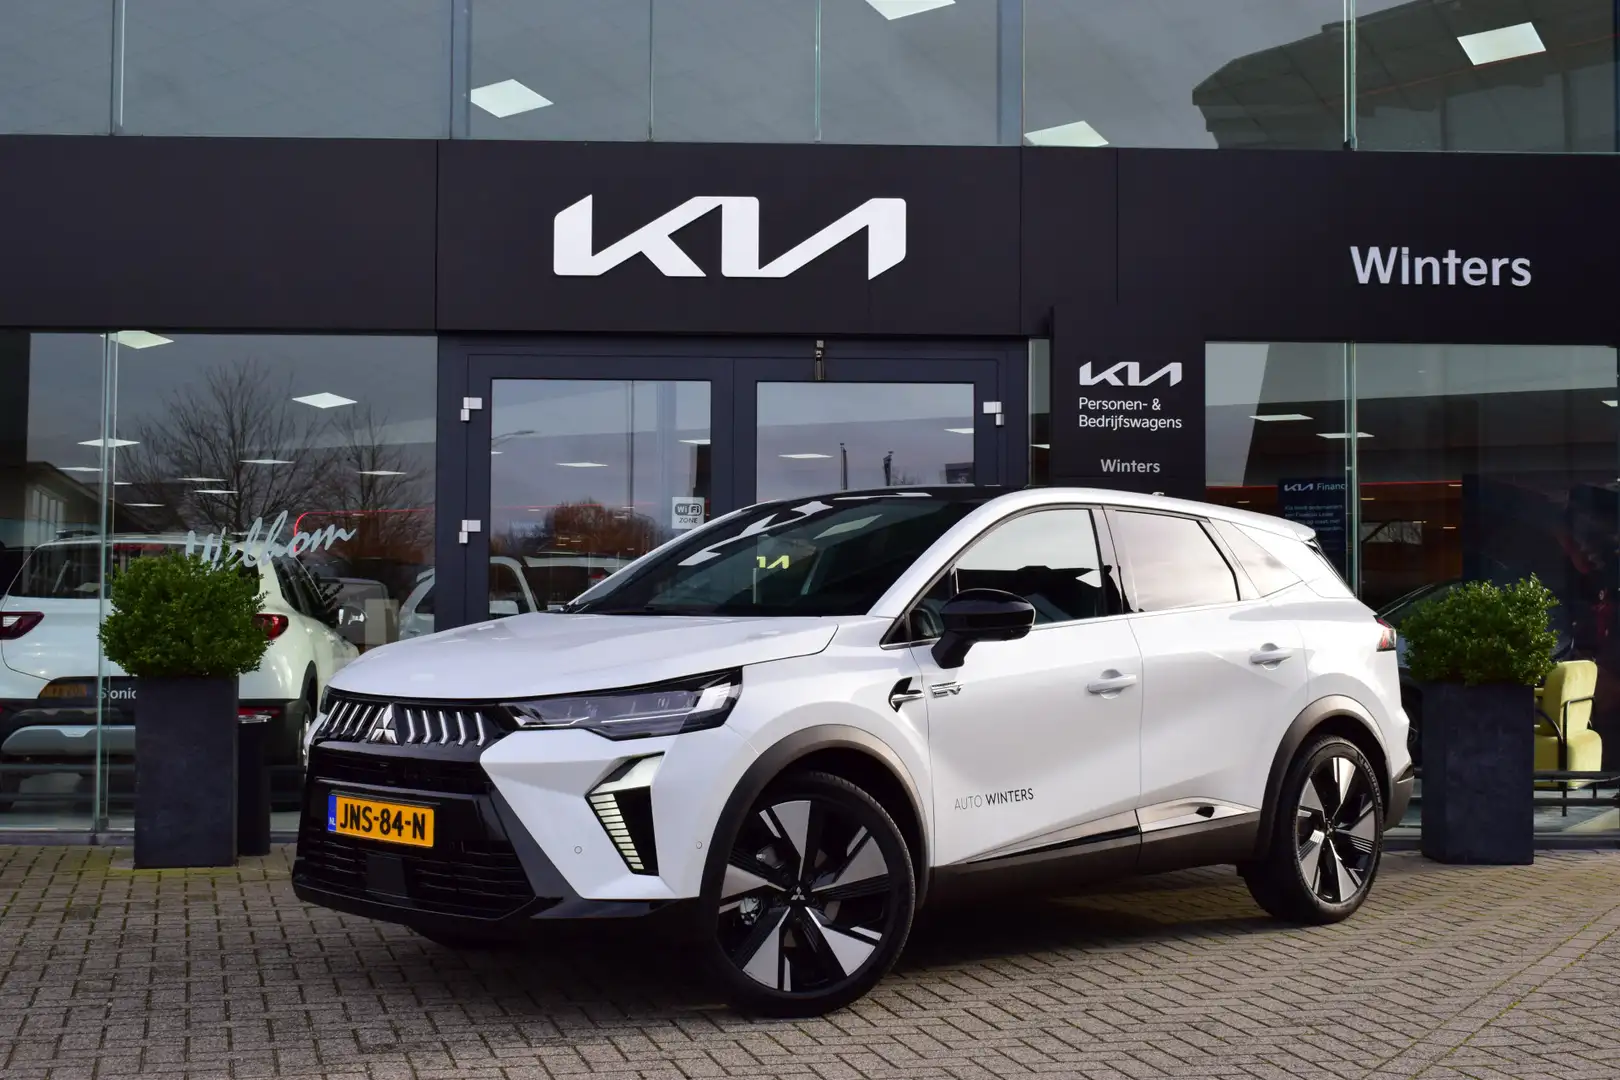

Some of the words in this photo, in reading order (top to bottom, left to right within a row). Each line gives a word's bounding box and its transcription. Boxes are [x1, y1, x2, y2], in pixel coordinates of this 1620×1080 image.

[553, 193, 906, 280] KIA
[1350, 246, 1532, 286] Winters
[1079, 361, 1182, 387] KIA
[1079, 397, 1148, 410] Personen-
[1151, 398, 1161, 410] &
[1079, 414, 1182, 431] Bedrijfswagens
[1100, 459, 1160, 473] Winters
[1317, 482, 1348, 490] Financ
[954, 795, 982, 810] AUTO
[985, 788, 1034, 805] WINTERS
[340, 803, 425, 840] JNS-84-N
